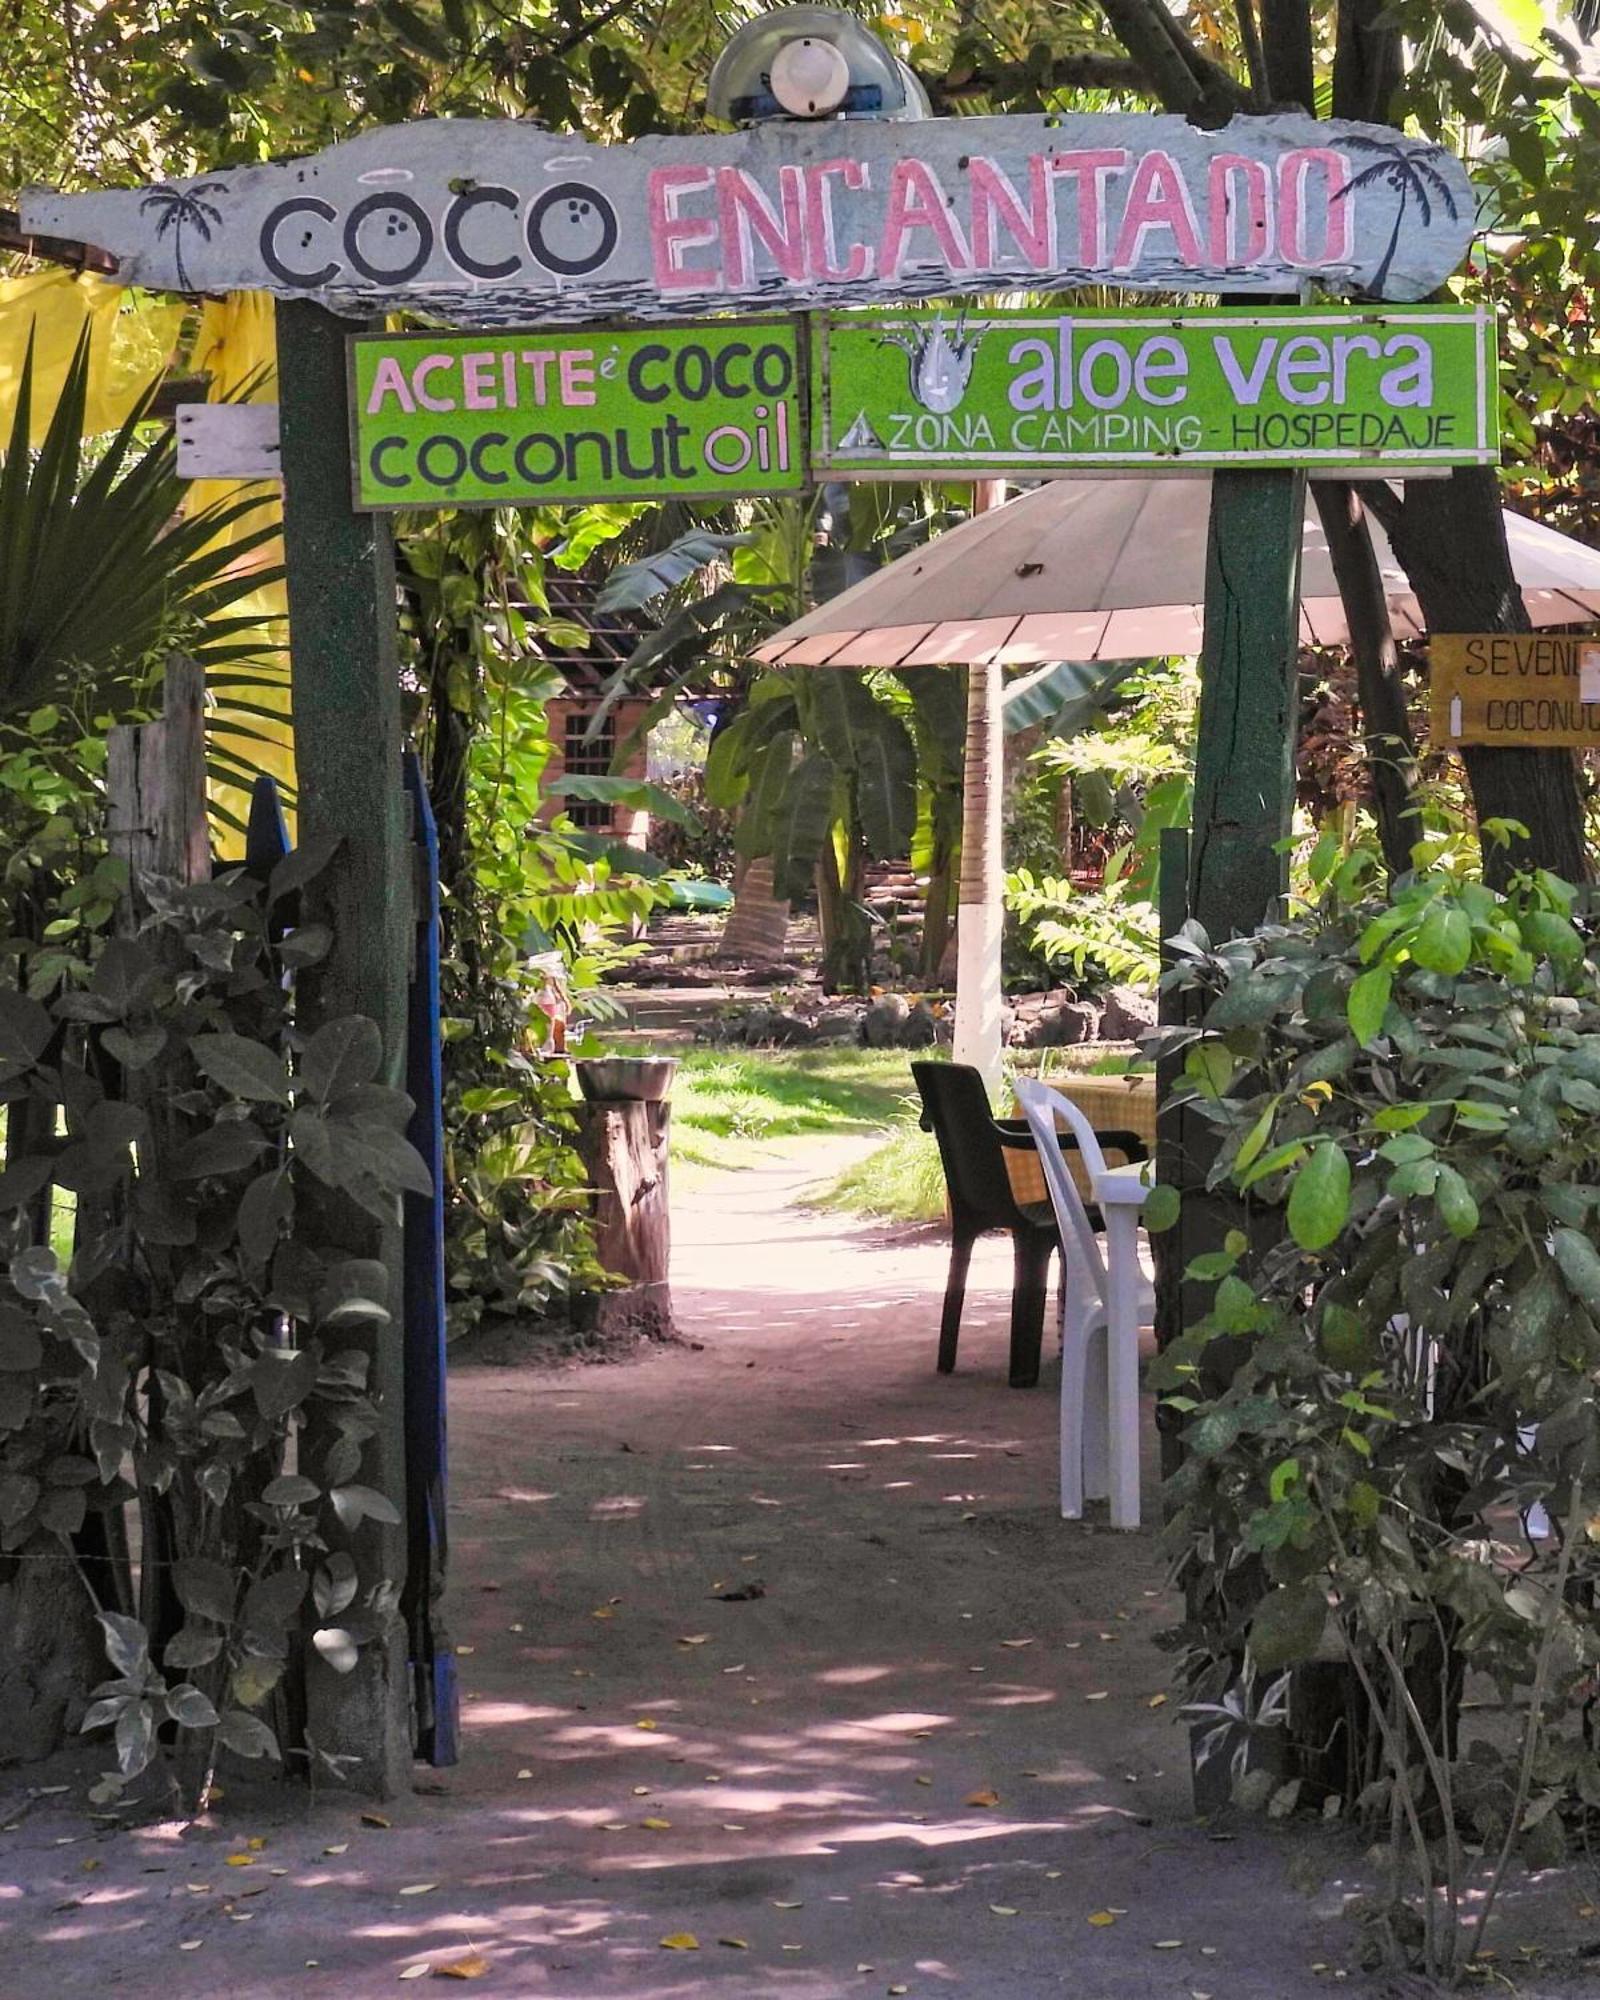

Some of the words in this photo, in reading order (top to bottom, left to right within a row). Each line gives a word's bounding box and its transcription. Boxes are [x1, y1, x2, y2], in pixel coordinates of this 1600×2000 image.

[259, 182, 619, 288] COCO
[647, 147, 1359, 299] ENCANTADO
[366, 349, 597, 414] ACEITE
[627, 343, 793, 402] COCO
[1007, 315, 1189, 411] aloe
[1212, 333, 1434, 407] vera
[369, 414, 697, 487] coconut
[703, 400, 790, 475] oil
[888, 413, 997, 450] ZONA
[1011, 413, 1202, 451] CAMPING
[1231, 413, 1456, 450] HOSPEDAJE
